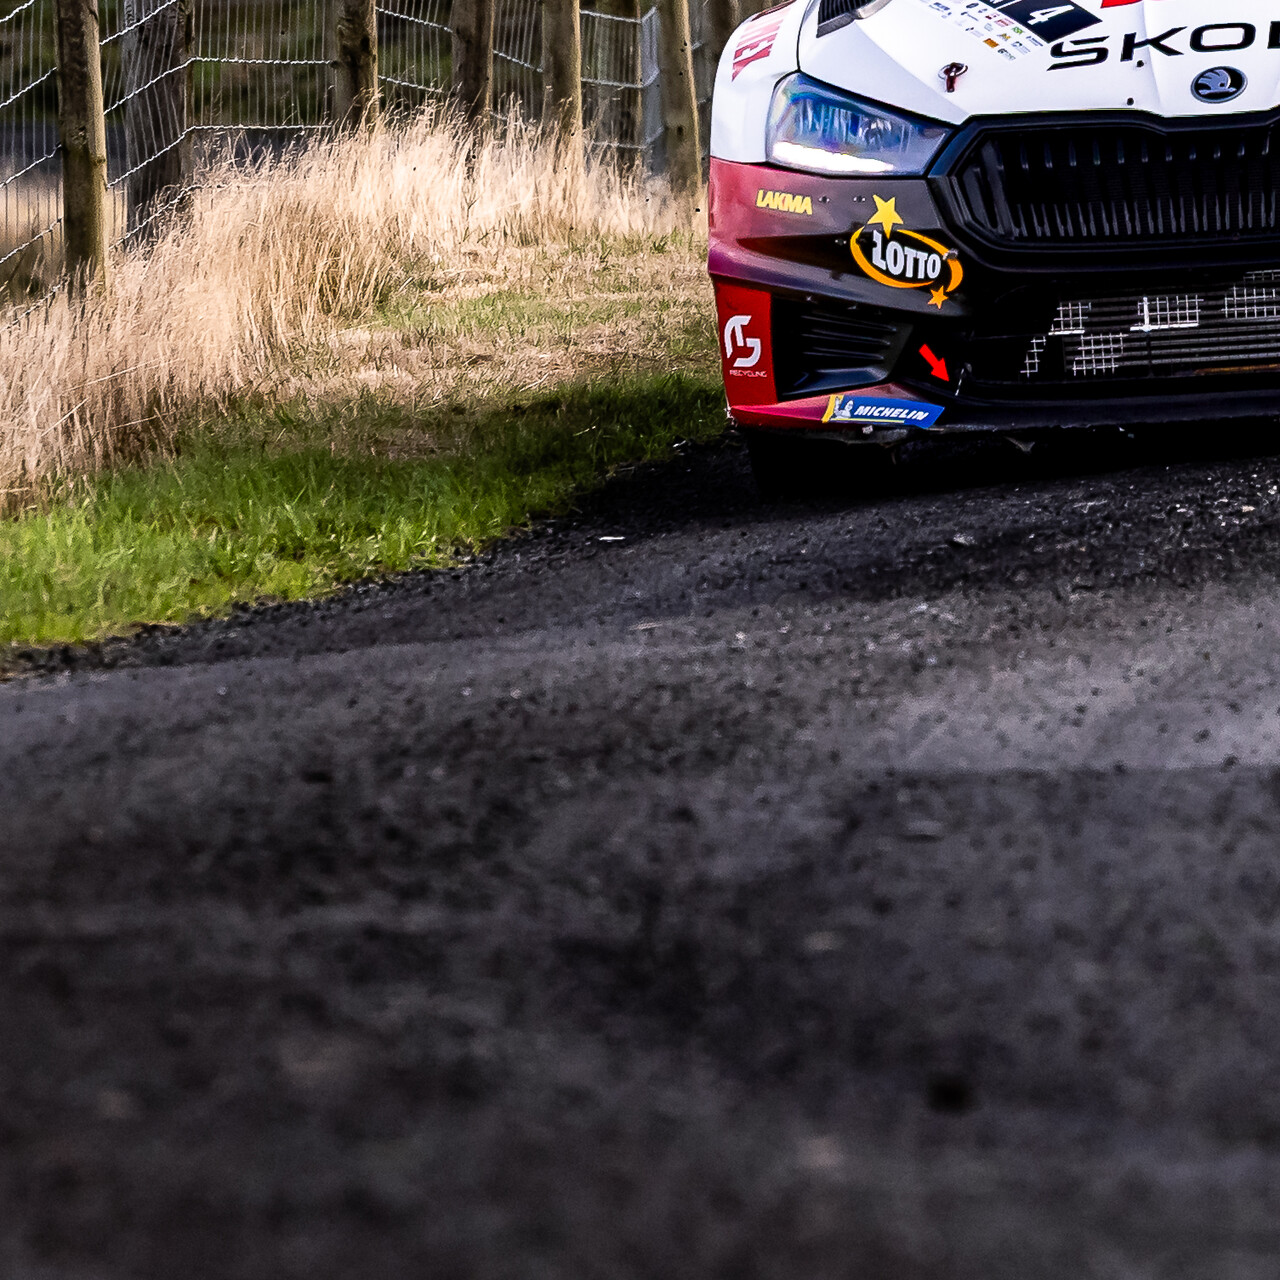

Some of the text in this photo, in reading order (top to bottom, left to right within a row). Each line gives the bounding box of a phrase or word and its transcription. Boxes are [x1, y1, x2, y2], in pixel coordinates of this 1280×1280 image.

[1026, 4, 1075, 26] 4
[756, 188, 814, 215] LAKMA
[872, 229, 942, 280] LOTTO
[853, 404, 930, 421] MICHELIN
